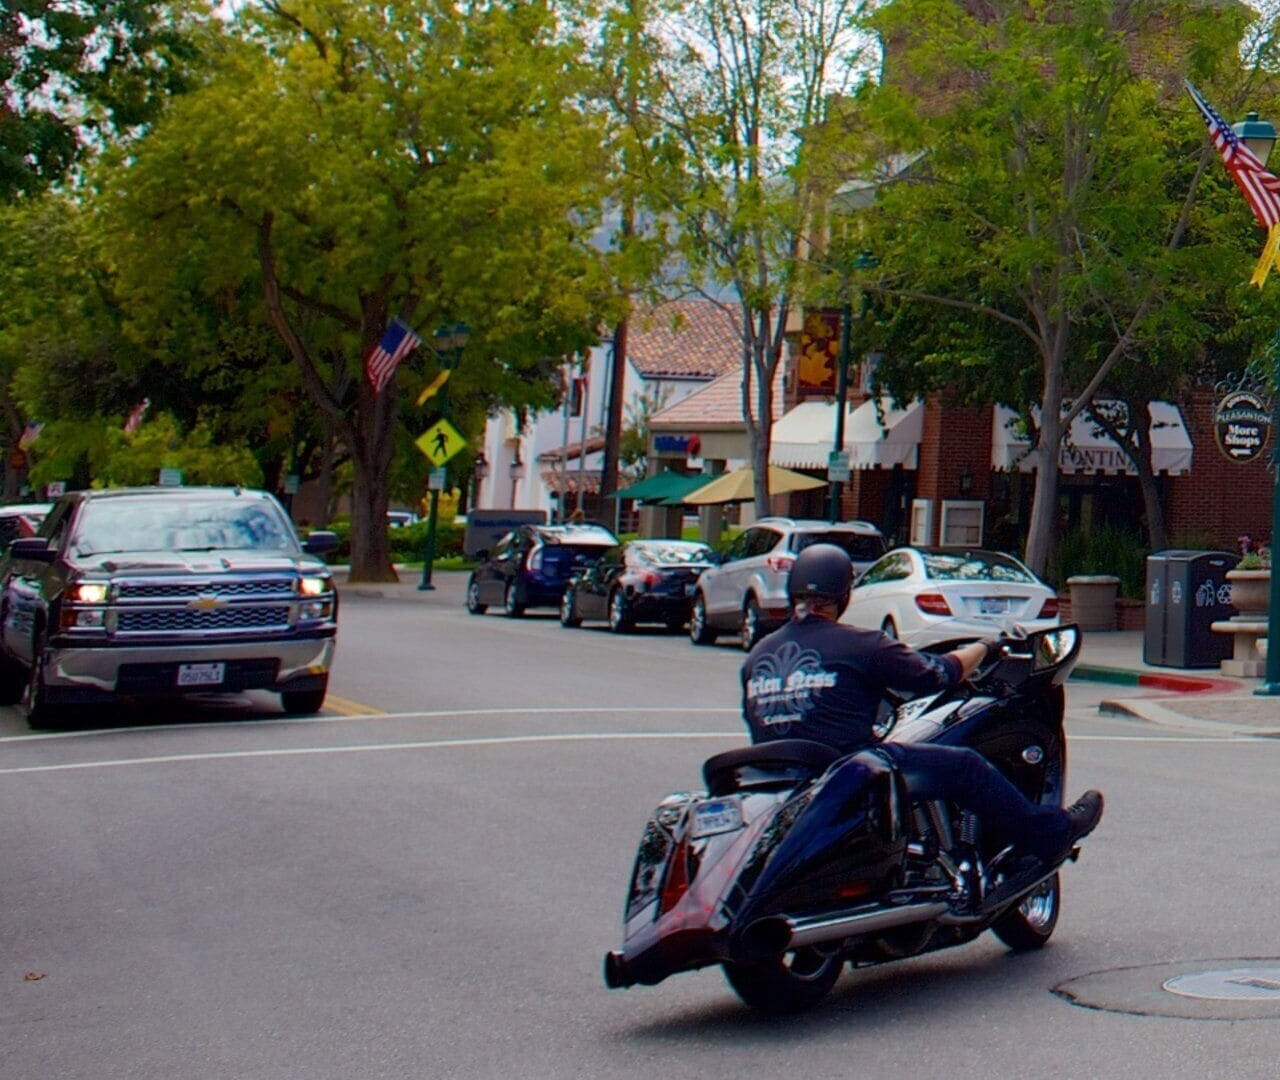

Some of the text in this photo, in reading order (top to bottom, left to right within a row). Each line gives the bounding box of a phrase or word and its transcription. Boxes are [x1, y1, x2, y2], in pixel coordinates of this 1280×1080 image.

[1217, 409, 1272, 424] PLEASANTON
[1228, 424, 1259, 436] More
[1224, 434, 1261, 448] Shops
[1061, 449, 1136, 467] FONTIN
